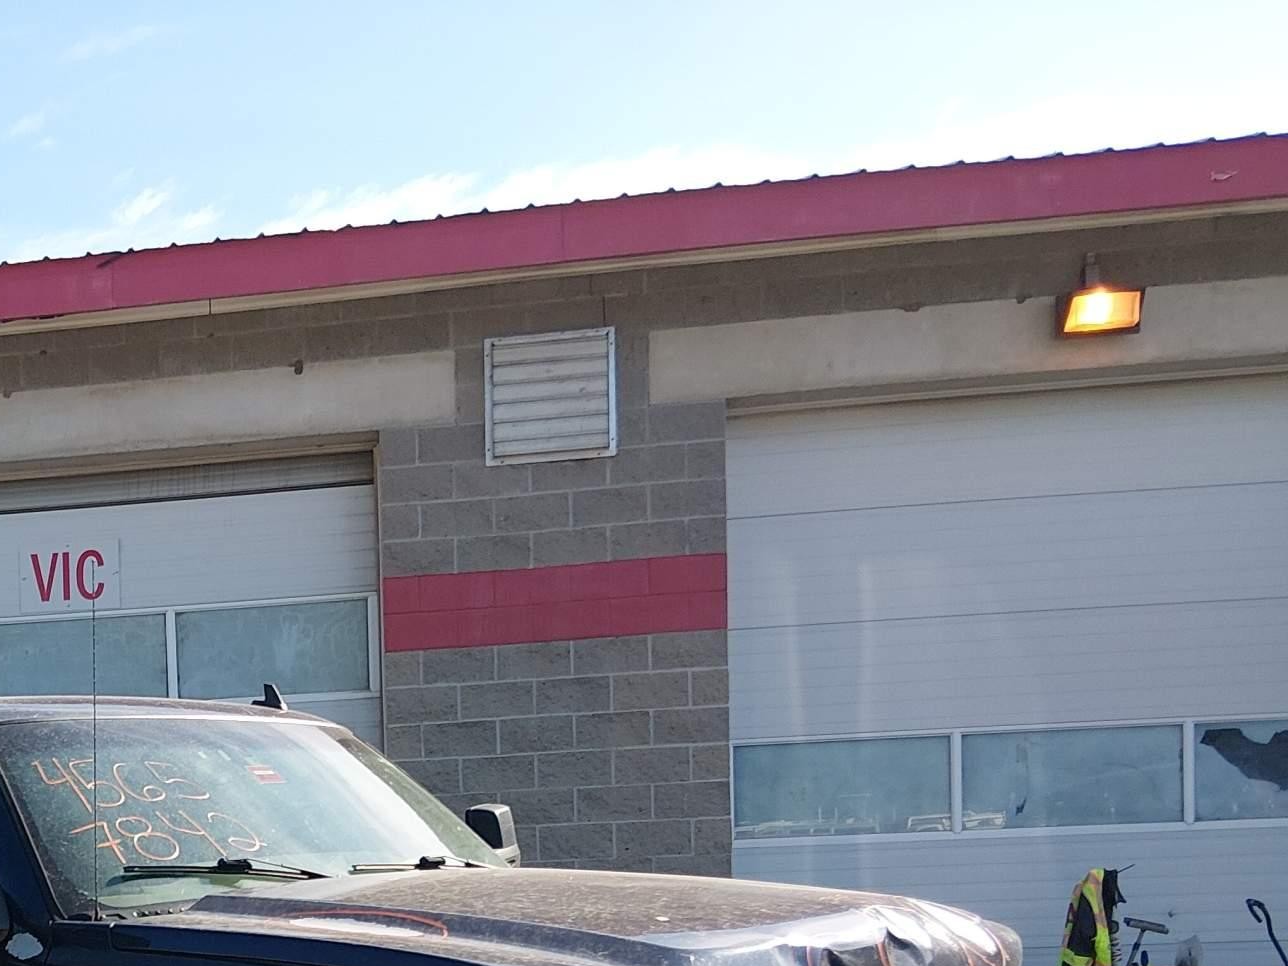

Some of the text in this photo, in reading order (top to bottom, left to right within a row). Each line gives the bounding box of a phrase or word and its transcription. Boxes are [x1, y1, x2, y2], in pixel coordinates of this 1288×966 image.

[30, 549, 105, 602] VIC
[31, 756, 210, 813] 4565
[68, 809, 268, 865] 7842
